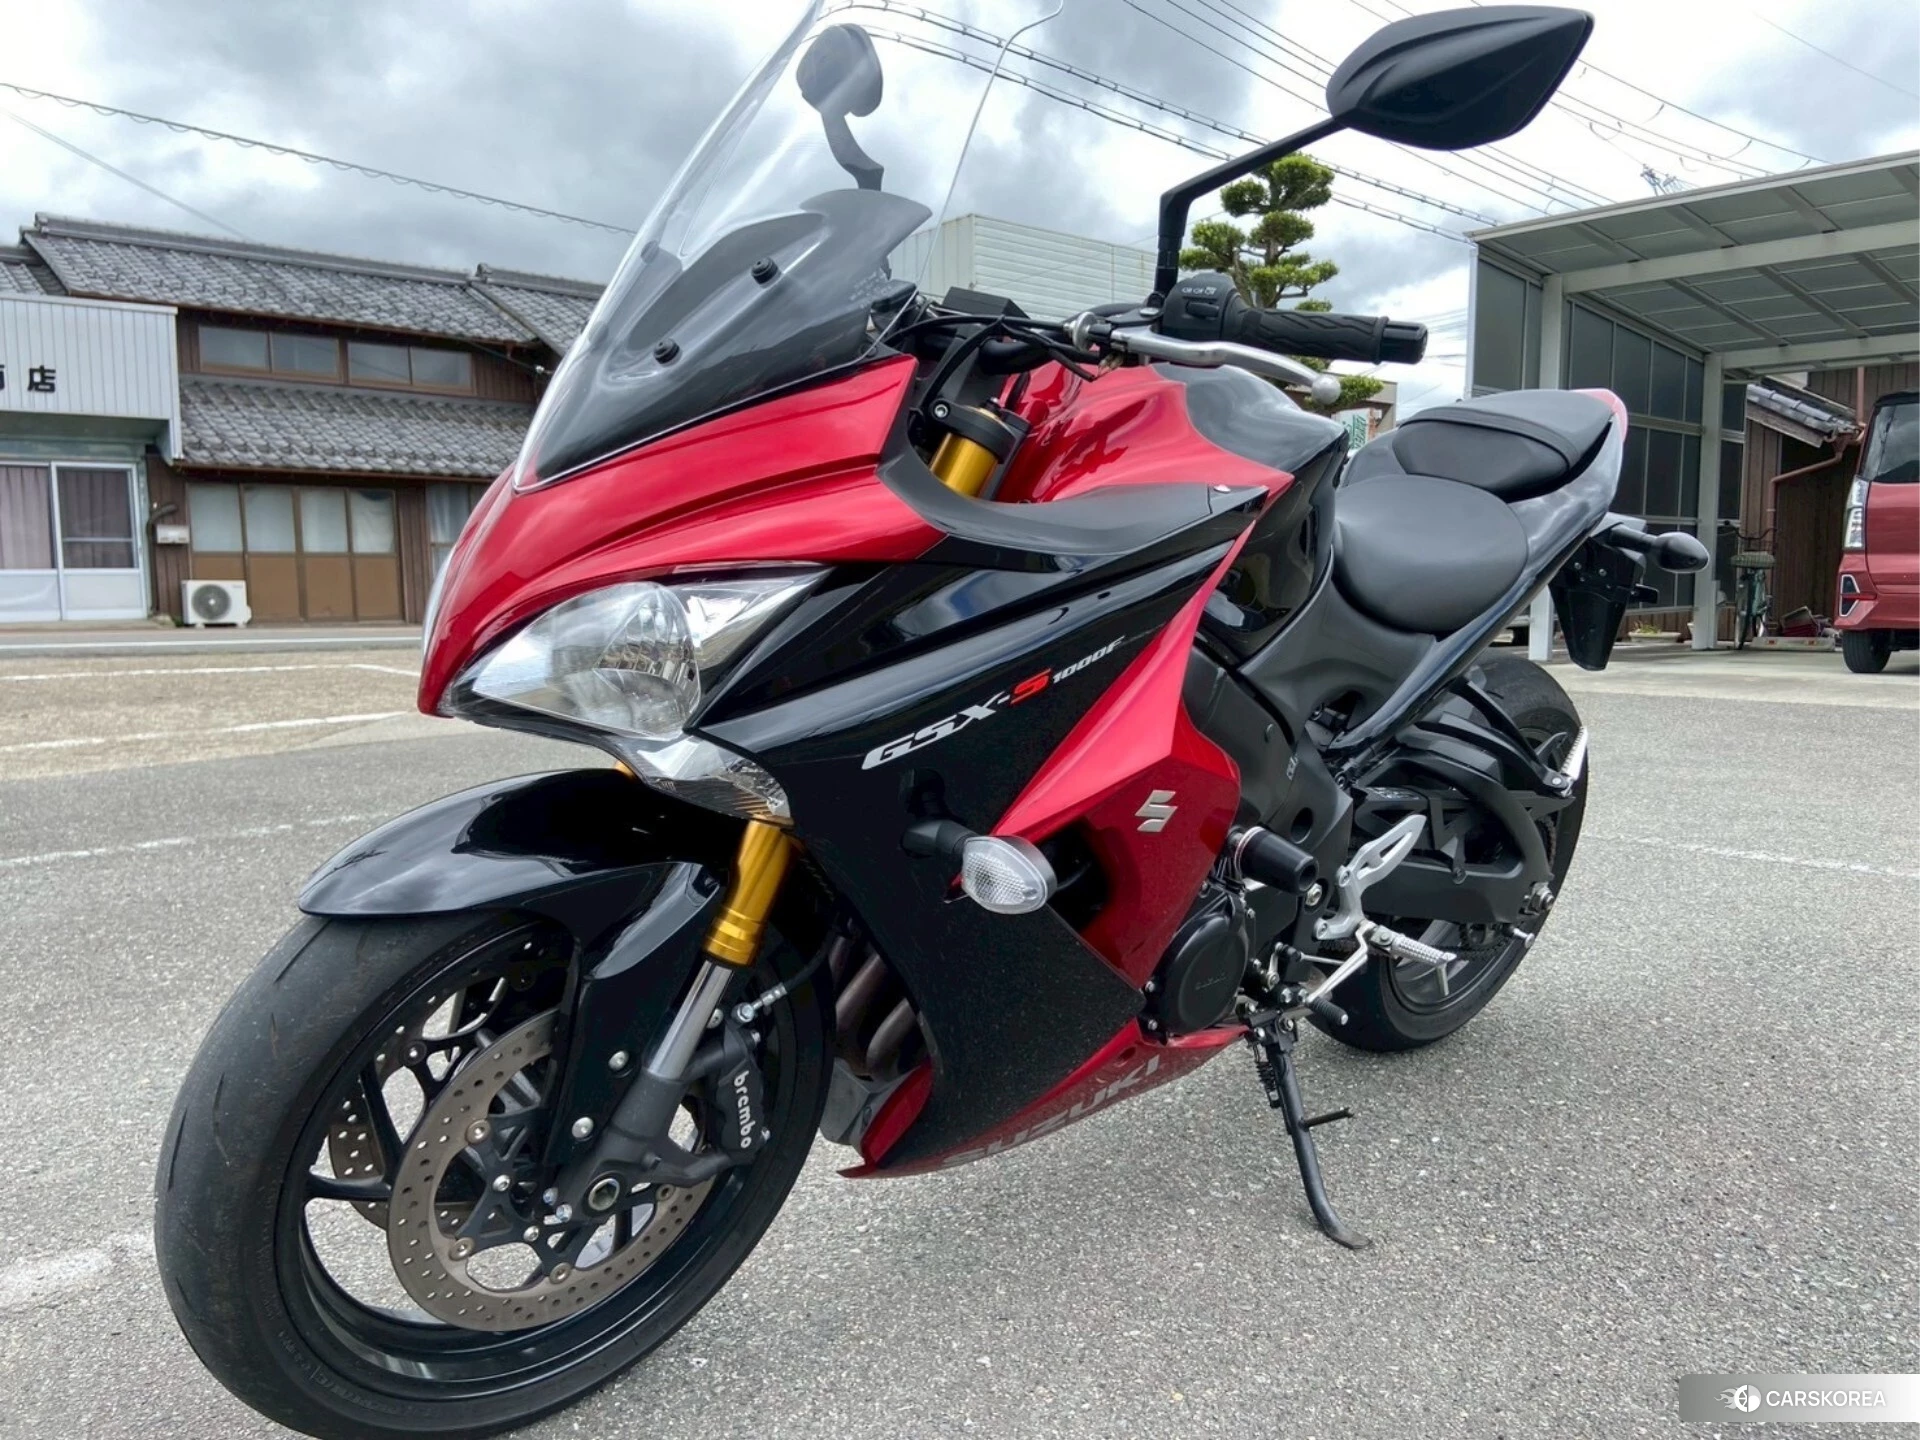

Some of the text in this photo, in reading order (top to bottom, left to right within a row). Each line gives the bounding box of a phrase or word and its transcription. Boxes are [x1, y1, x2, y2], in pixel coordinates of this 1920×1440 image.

[0, 364, 56, 393] 店
[733, 1070, 756, 1148] brembo
[942, 1054, 1160, 1167] SUZUKI
